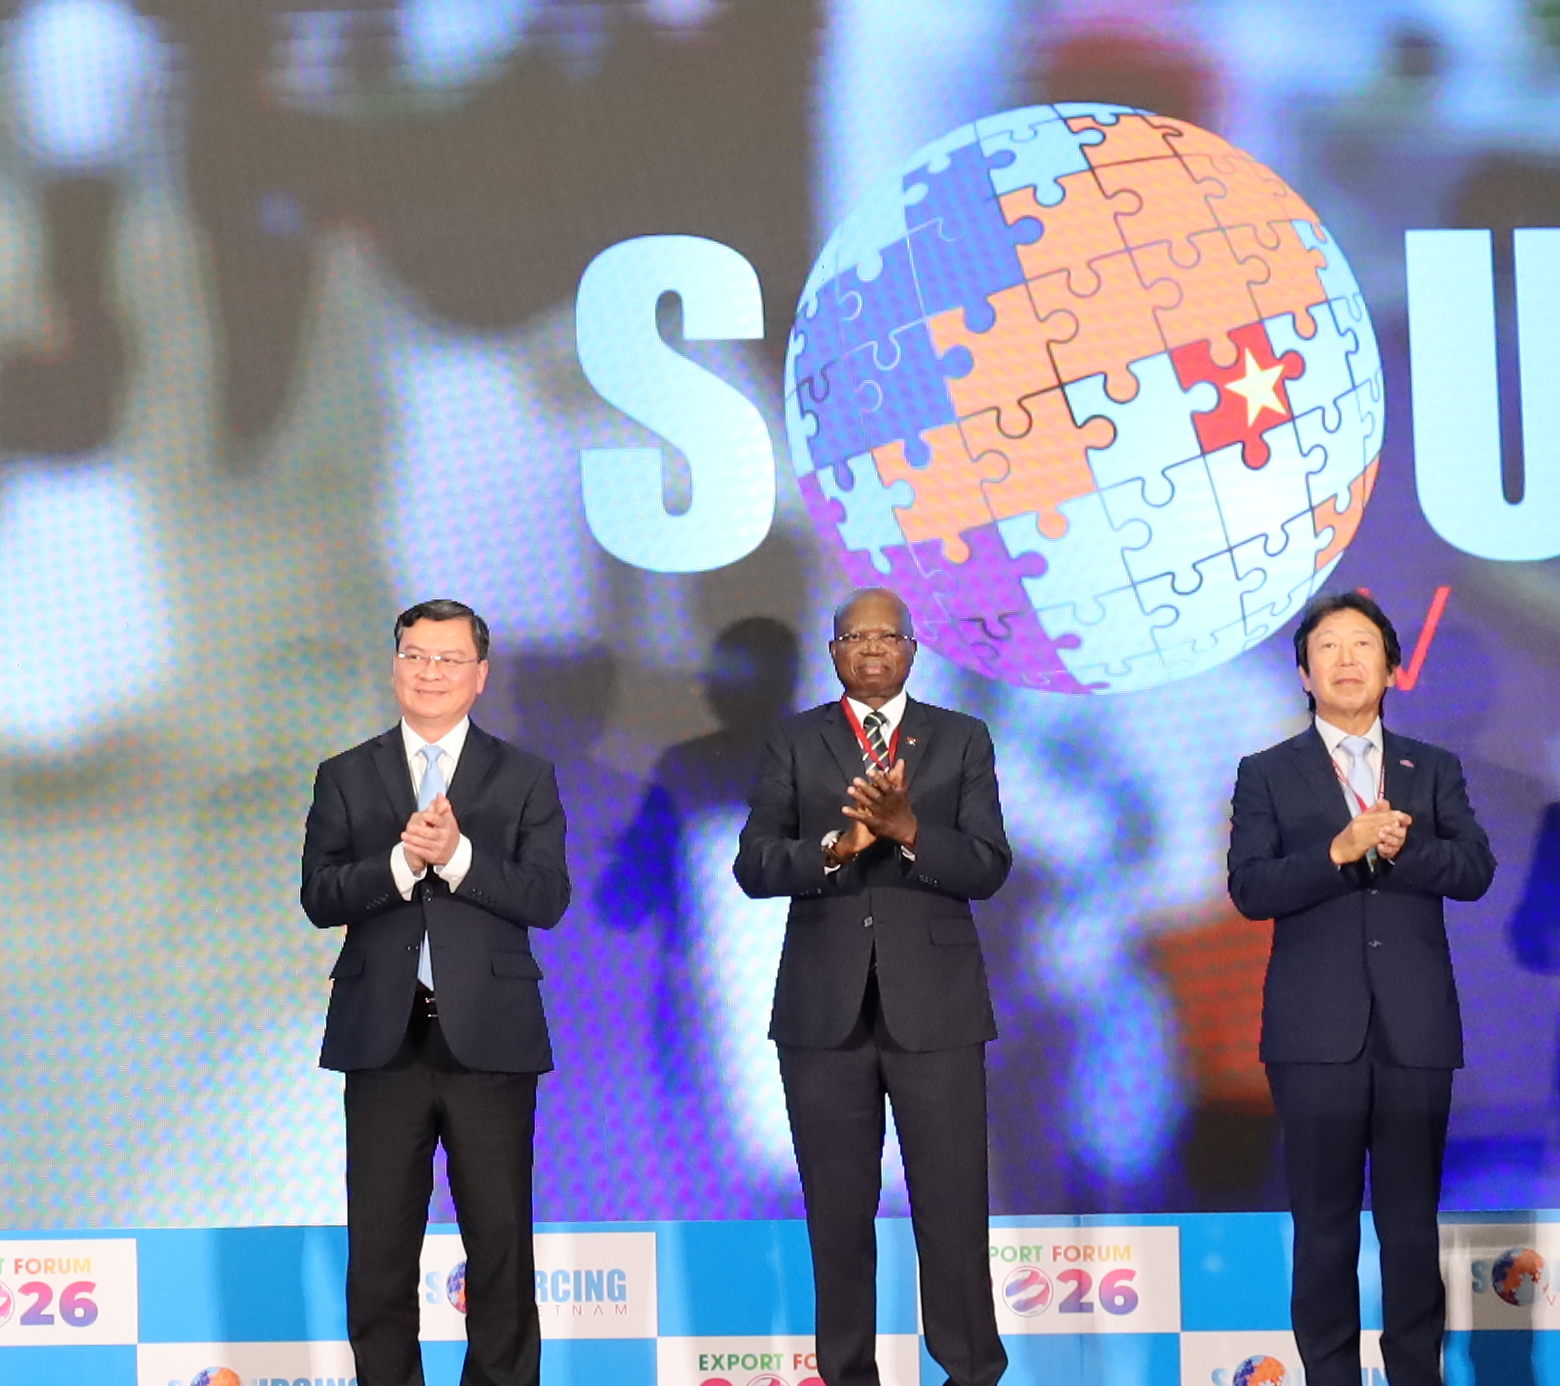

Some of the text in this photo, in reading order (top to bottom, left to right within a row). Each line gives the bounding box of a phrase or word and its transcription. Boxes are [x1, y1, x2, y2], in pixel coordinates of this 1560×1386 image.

[988, 1244, 1132, 1263] PORT FORUM
[13, 1256, 92, 1276] FORUM
[698, 1353, 784, 1372] EXPORT
